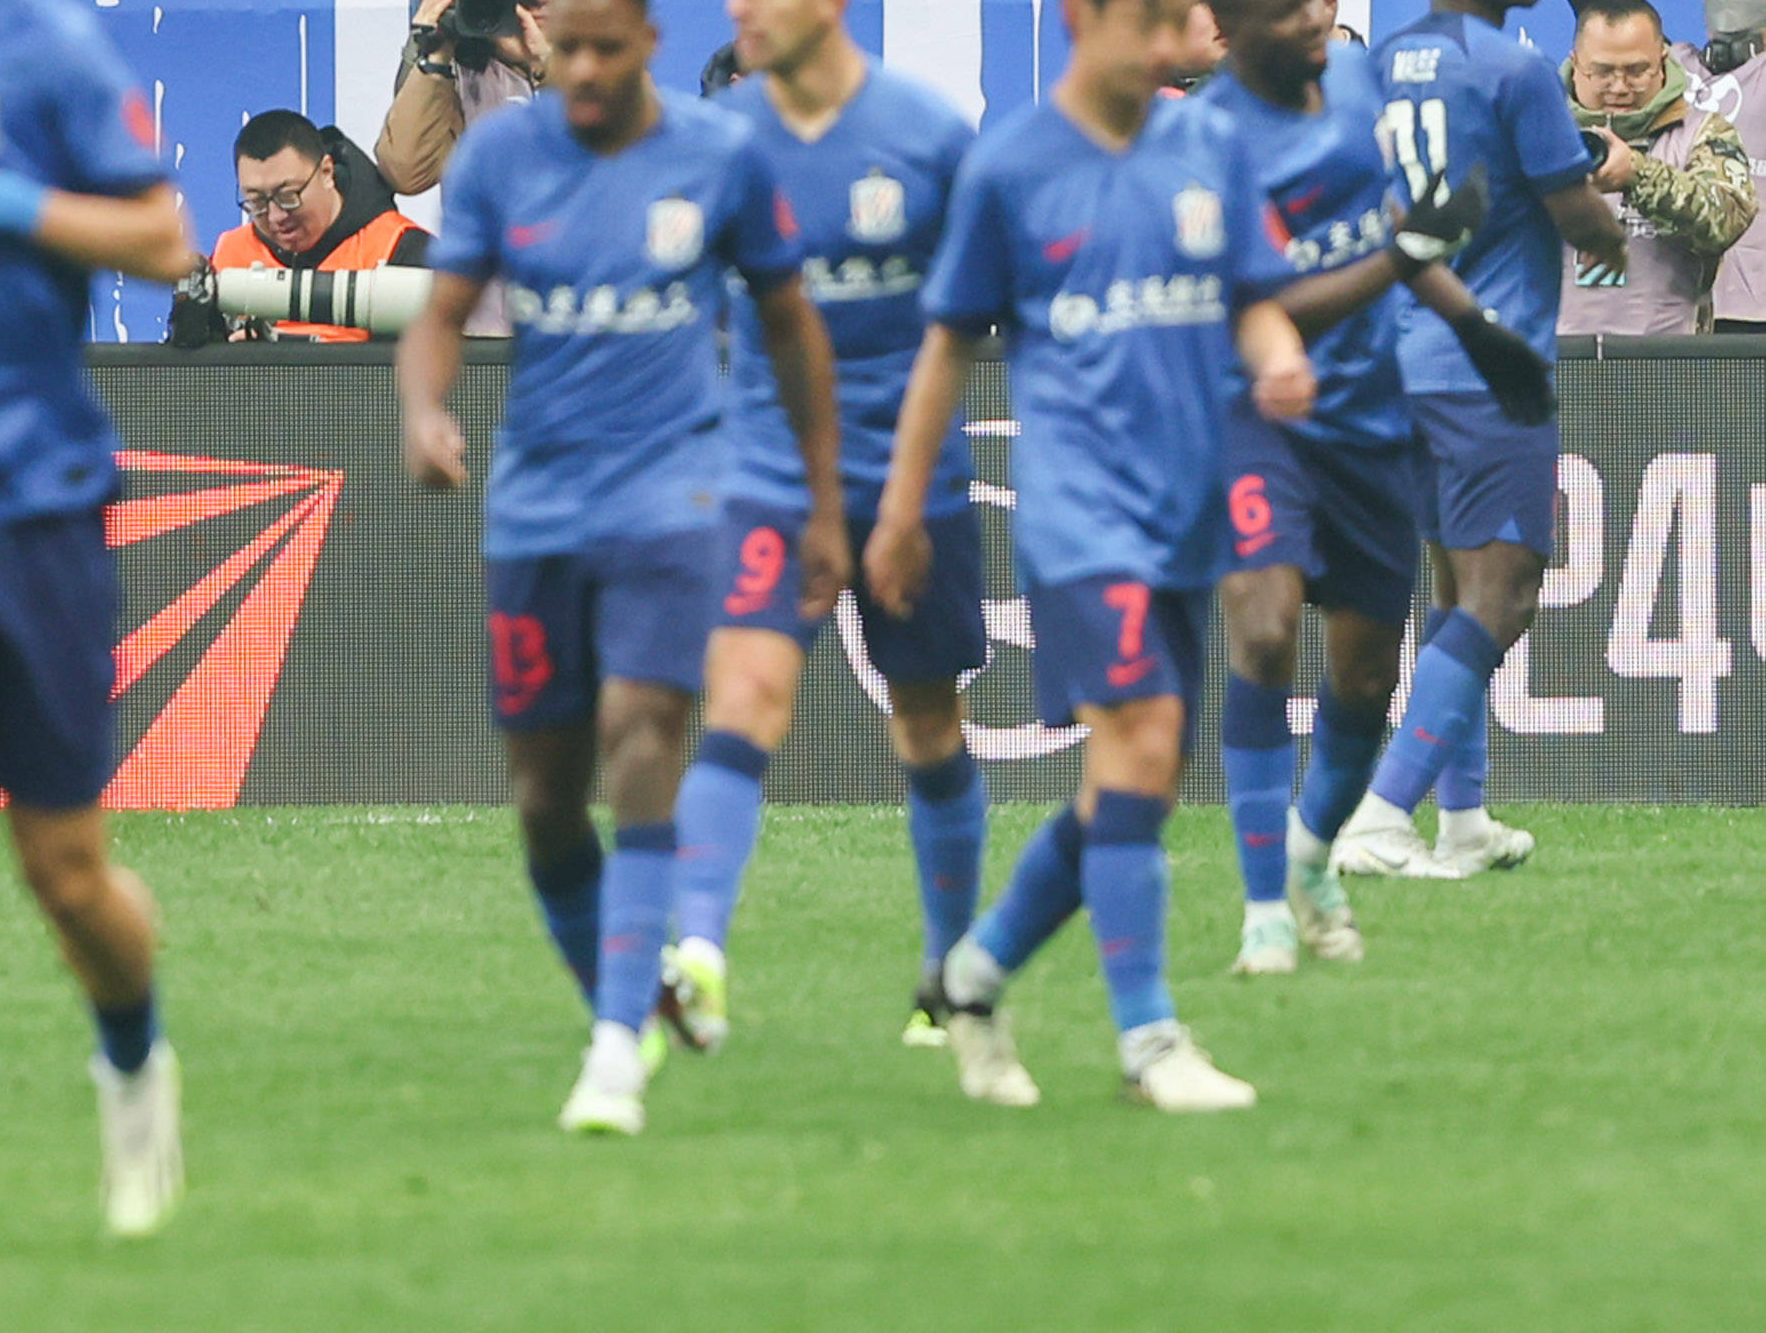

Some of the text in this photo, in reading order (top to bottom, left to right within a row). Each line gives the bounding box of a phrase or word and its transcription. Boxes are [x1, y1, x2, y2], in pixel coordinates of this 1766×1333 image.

[1229, 474, 1274, 537] 6
[736, 525, 786, 594] 9
[1103, 582, 1151, 657] 7
